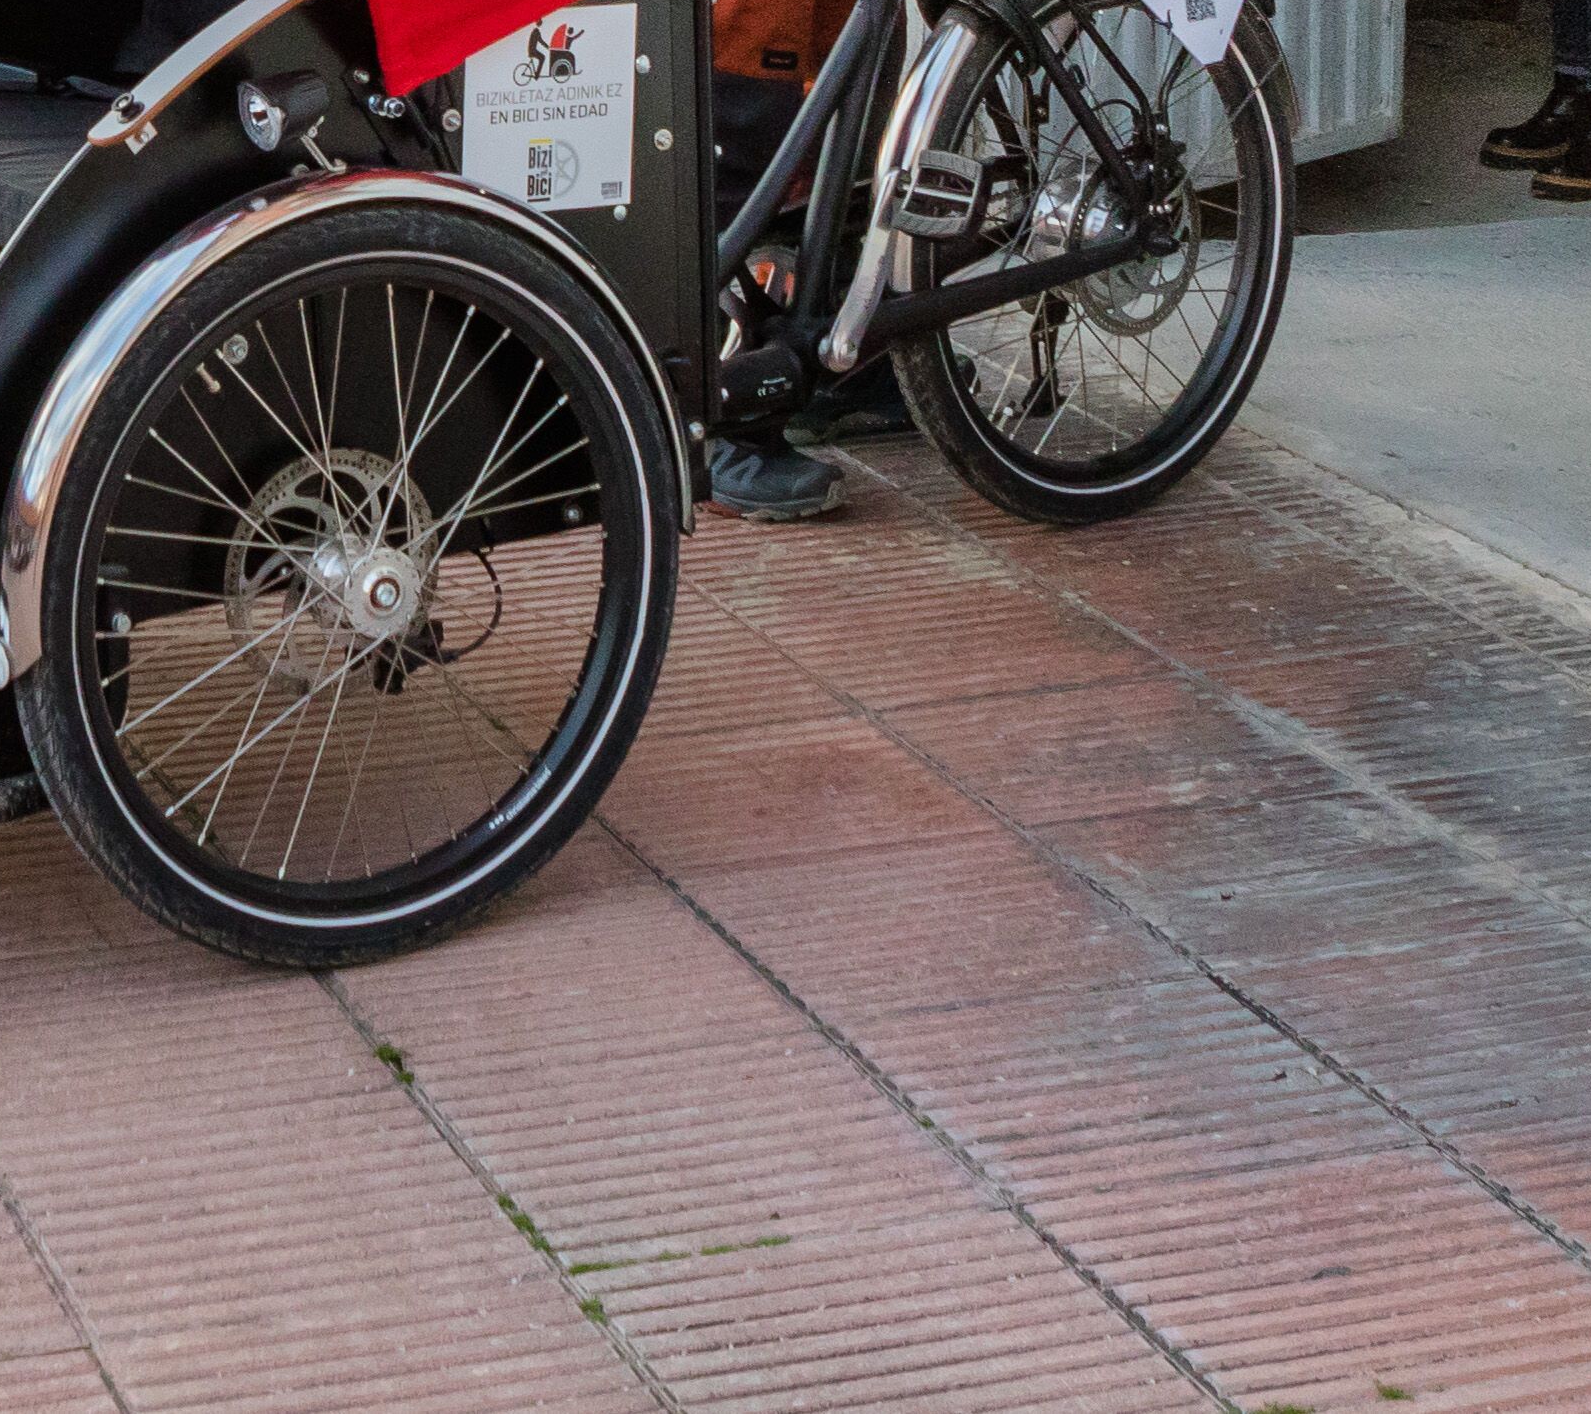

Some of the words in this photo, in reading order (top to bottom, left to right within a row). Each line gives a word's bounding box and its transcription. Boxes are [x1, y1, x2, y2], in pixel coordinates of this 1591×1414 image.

[476, 88, 554, 108] BIZIKLETAZ
[556, 84, 603, 102] ADINIK
[606, 82, 624, 99] EZ
[490, 110, 509, 125] EN
[512, 108, 539, 124] BICI
[543, 106, 566, 121] SIN
[569, 102, 608, 119] EDAD
[528, 144, 553, 169] Bizi
[527, 172, 552, 197] Bici
